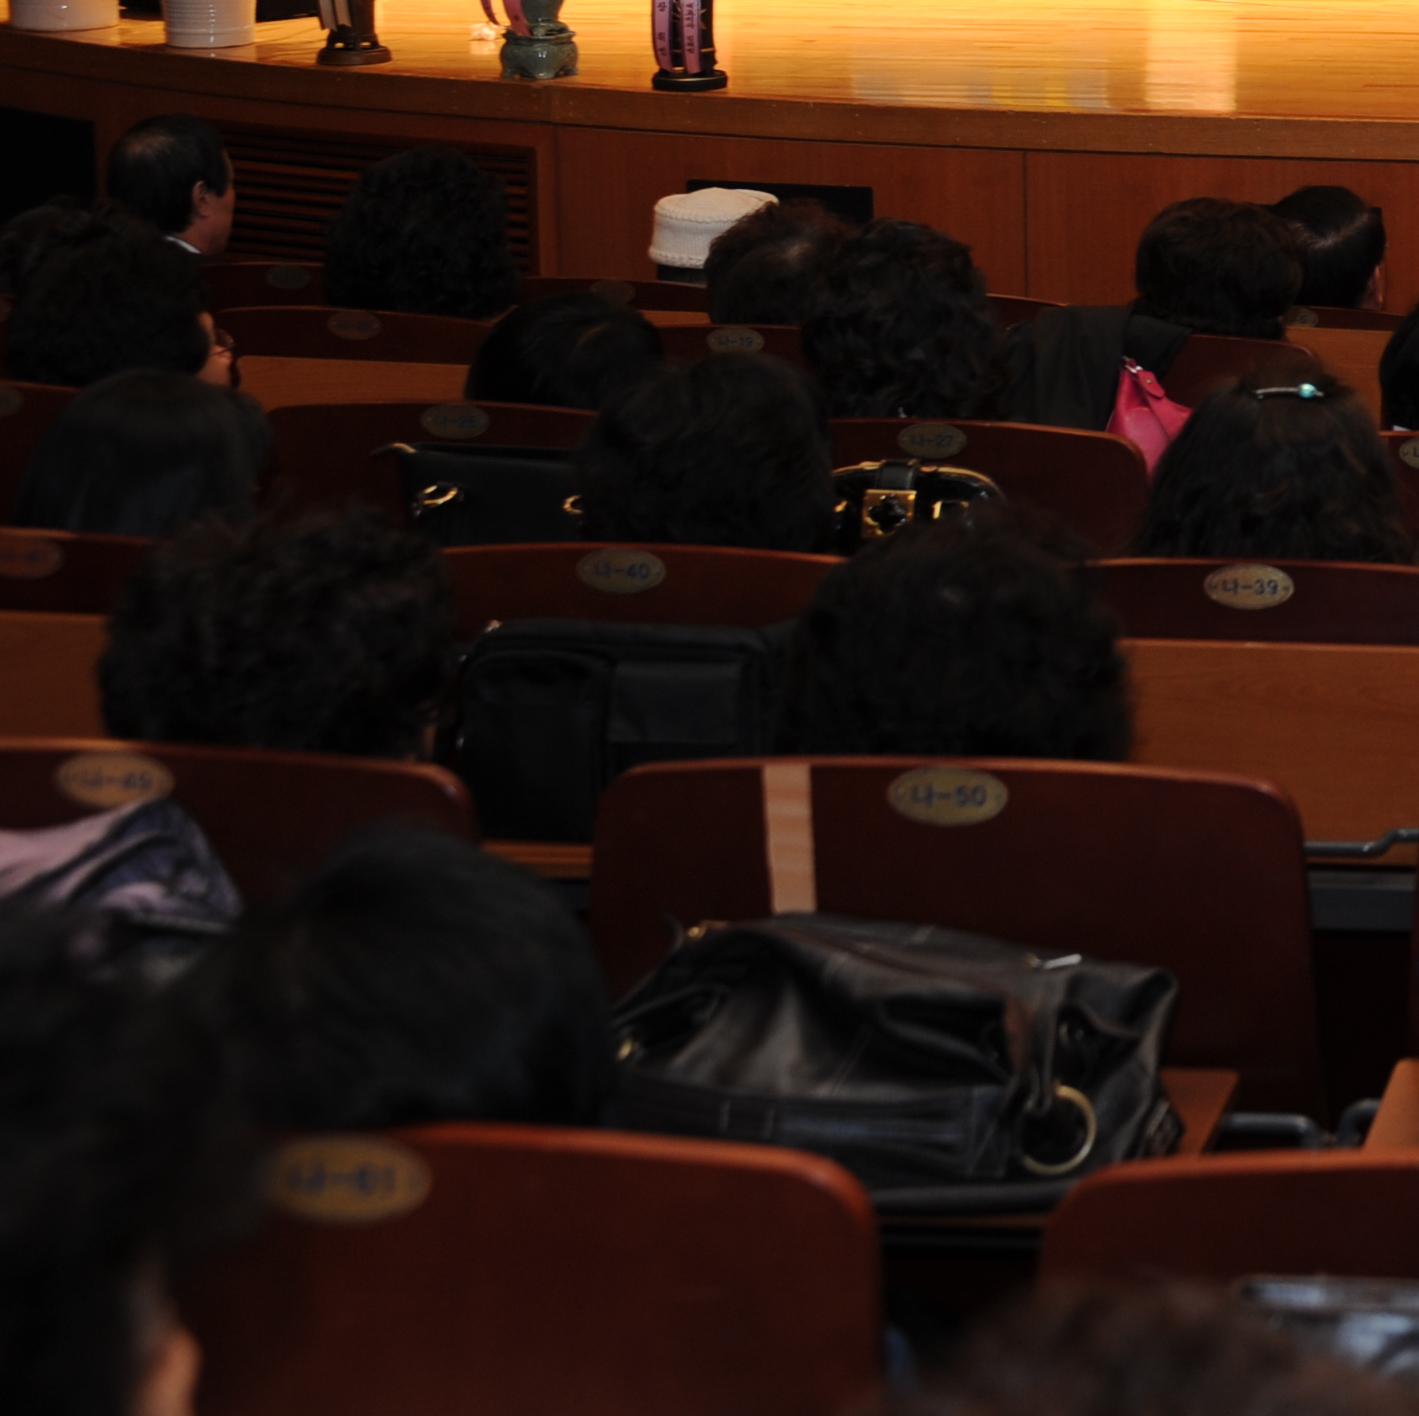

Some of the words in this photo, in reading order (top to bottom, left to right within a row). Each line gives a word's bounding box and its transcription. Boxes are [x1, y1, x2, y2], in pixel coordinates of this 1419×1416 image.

[912, 431, 955, 449] 나-27
[593, 561, 650, 579] 나-40
[1221, 578, 1280, 596] 나-39
[911, 783, 988, 809] 나-50
